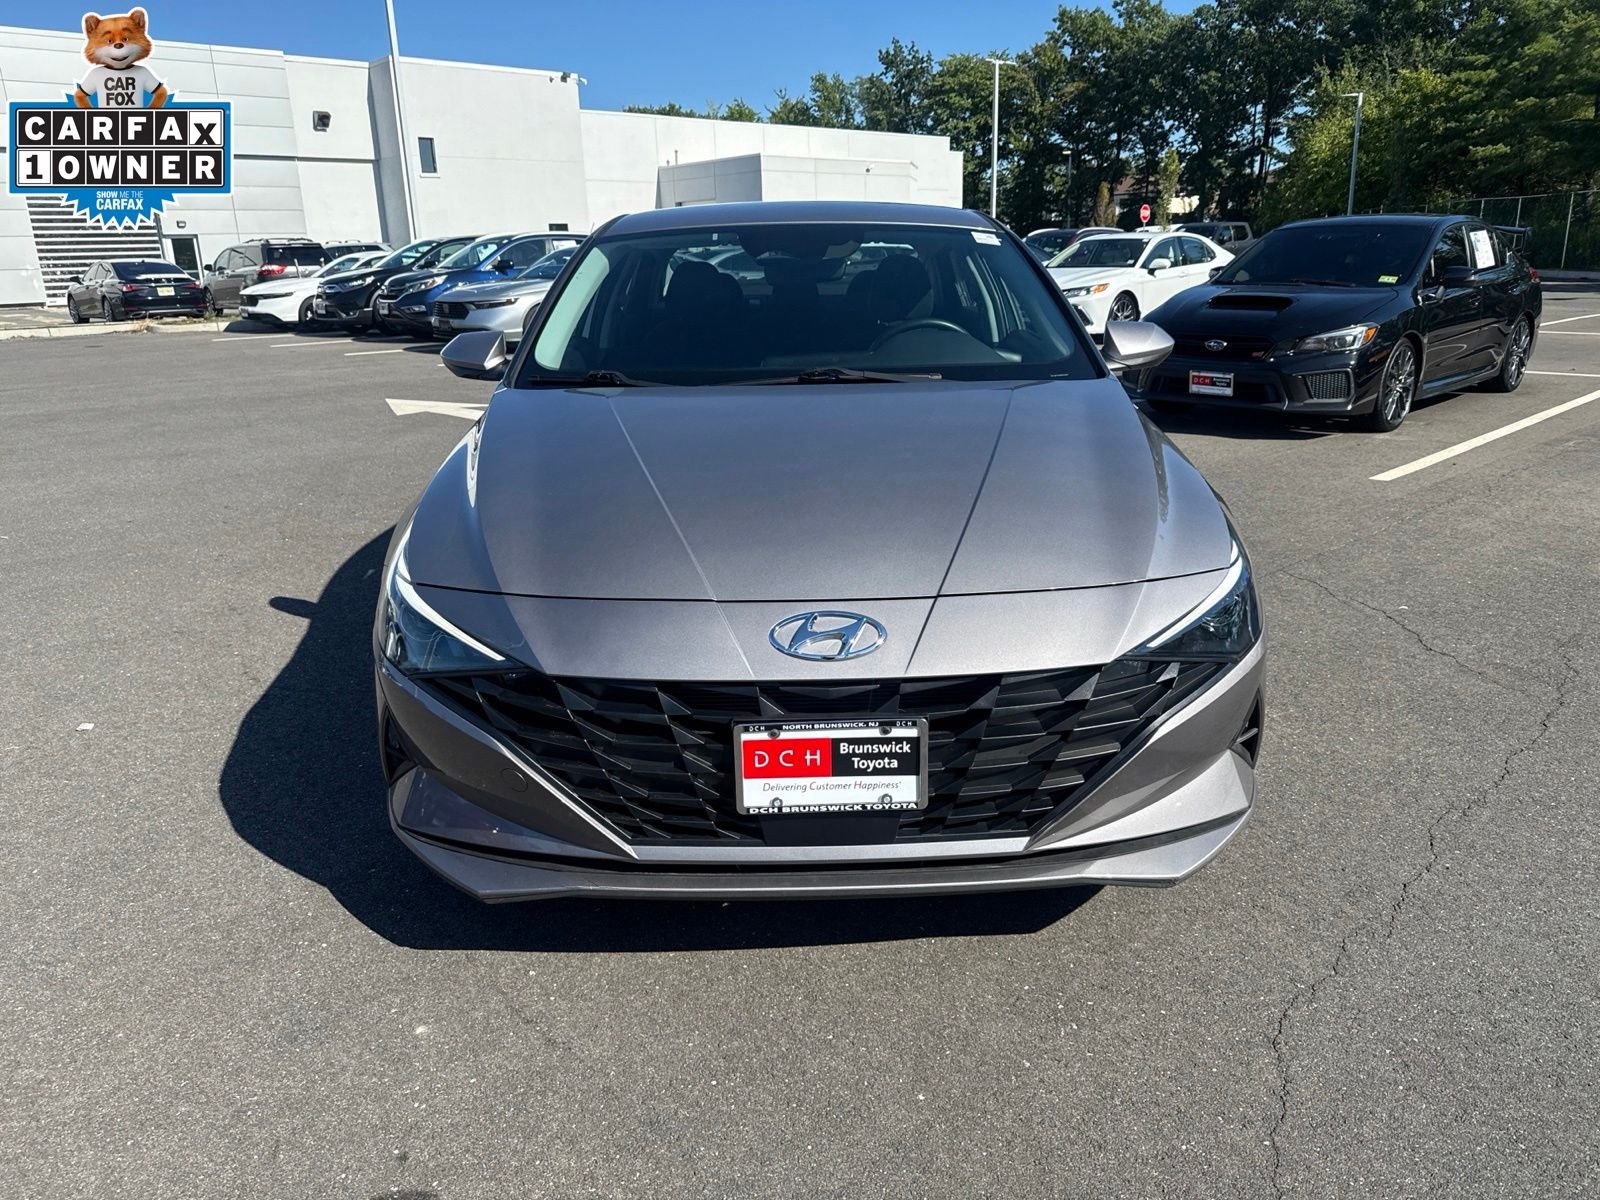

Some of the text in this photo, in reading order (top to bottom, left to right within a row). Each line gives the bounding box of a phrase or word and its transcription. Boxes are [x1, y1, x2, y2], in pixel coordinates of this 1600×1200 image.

[782, 723, 812, 731] NORTH
[839, 740, 911, 754] Brunswick
[851, 756, 899, 772] Toyota
[762, 780, 900, 793] Delivering Customer Happiness
[781, 804, 863, 813] BRUNSWICK
[865, 802, 918, 811] TOYOTA
